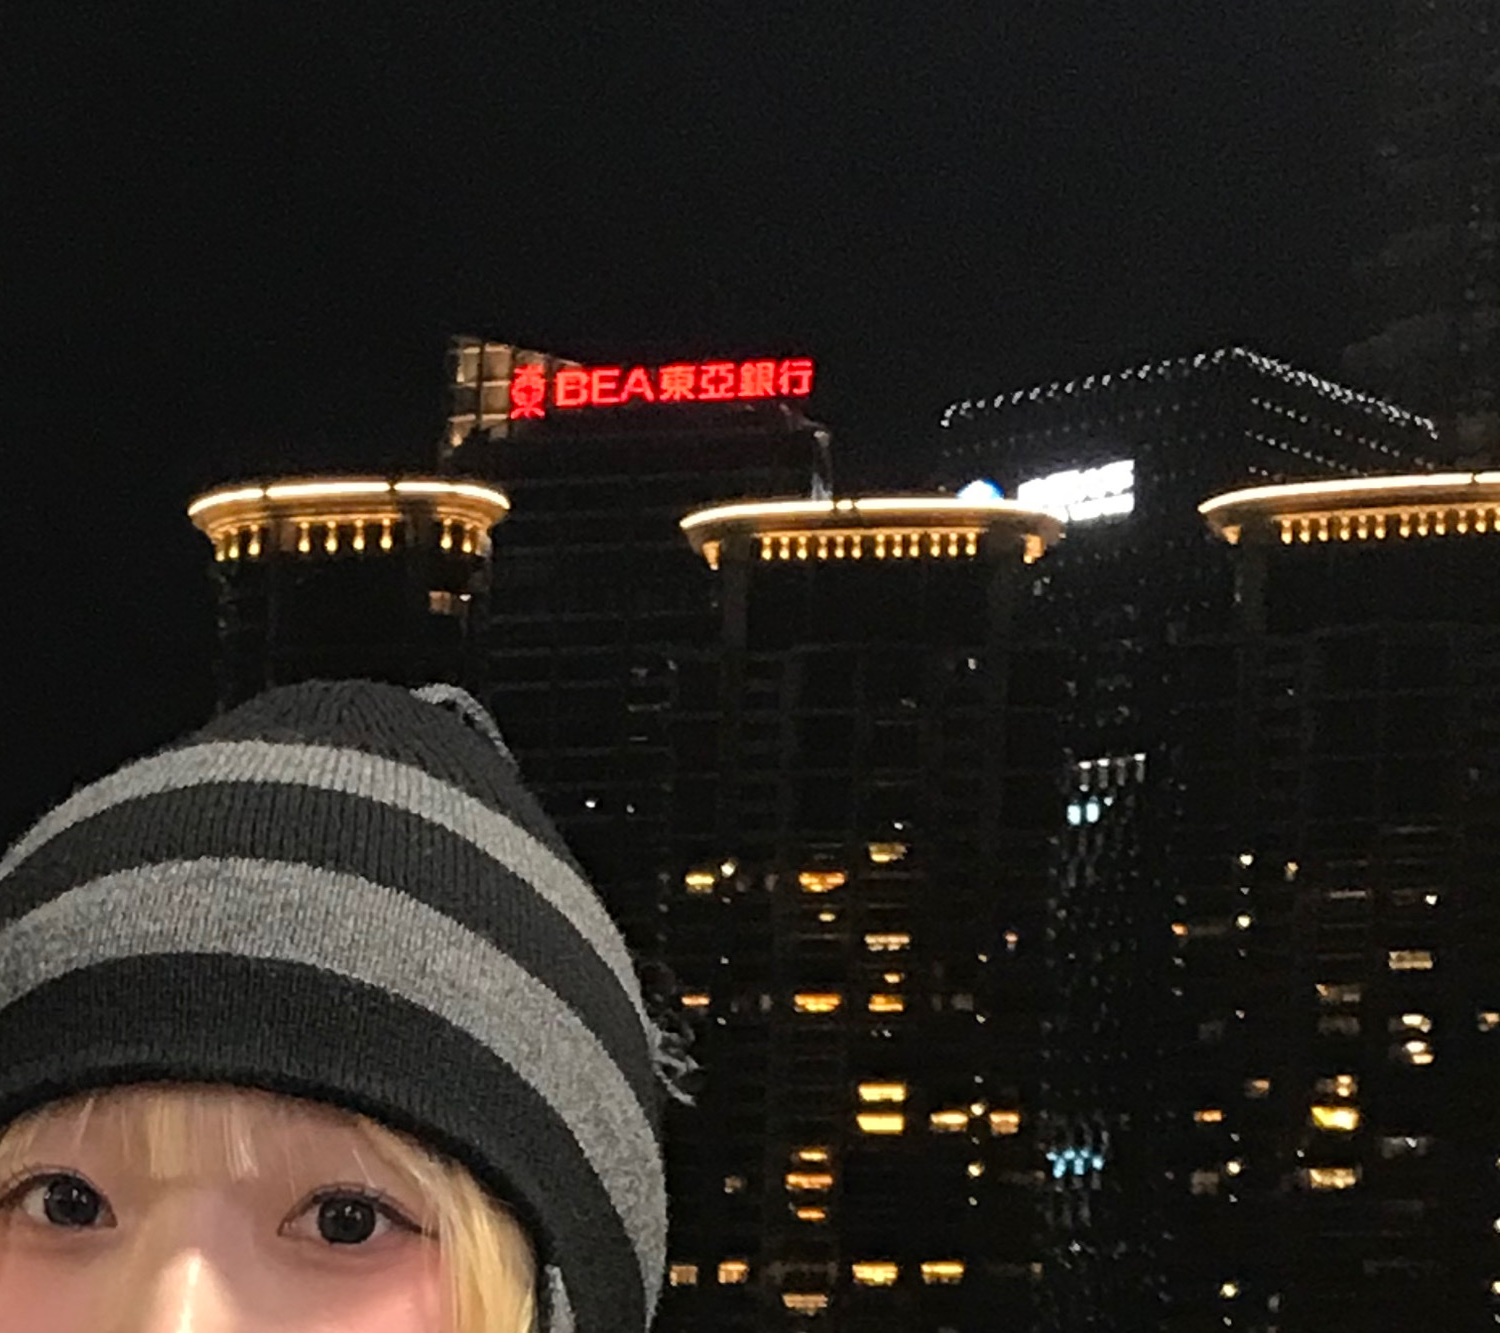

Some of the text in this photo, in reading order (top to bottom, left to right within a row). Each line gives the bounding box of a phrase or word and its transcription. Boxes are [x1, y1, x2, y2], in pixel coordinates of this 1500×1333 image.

[554, 366, 655, 407] BEA
[658, 359, 814, 401] 東亞銀行
